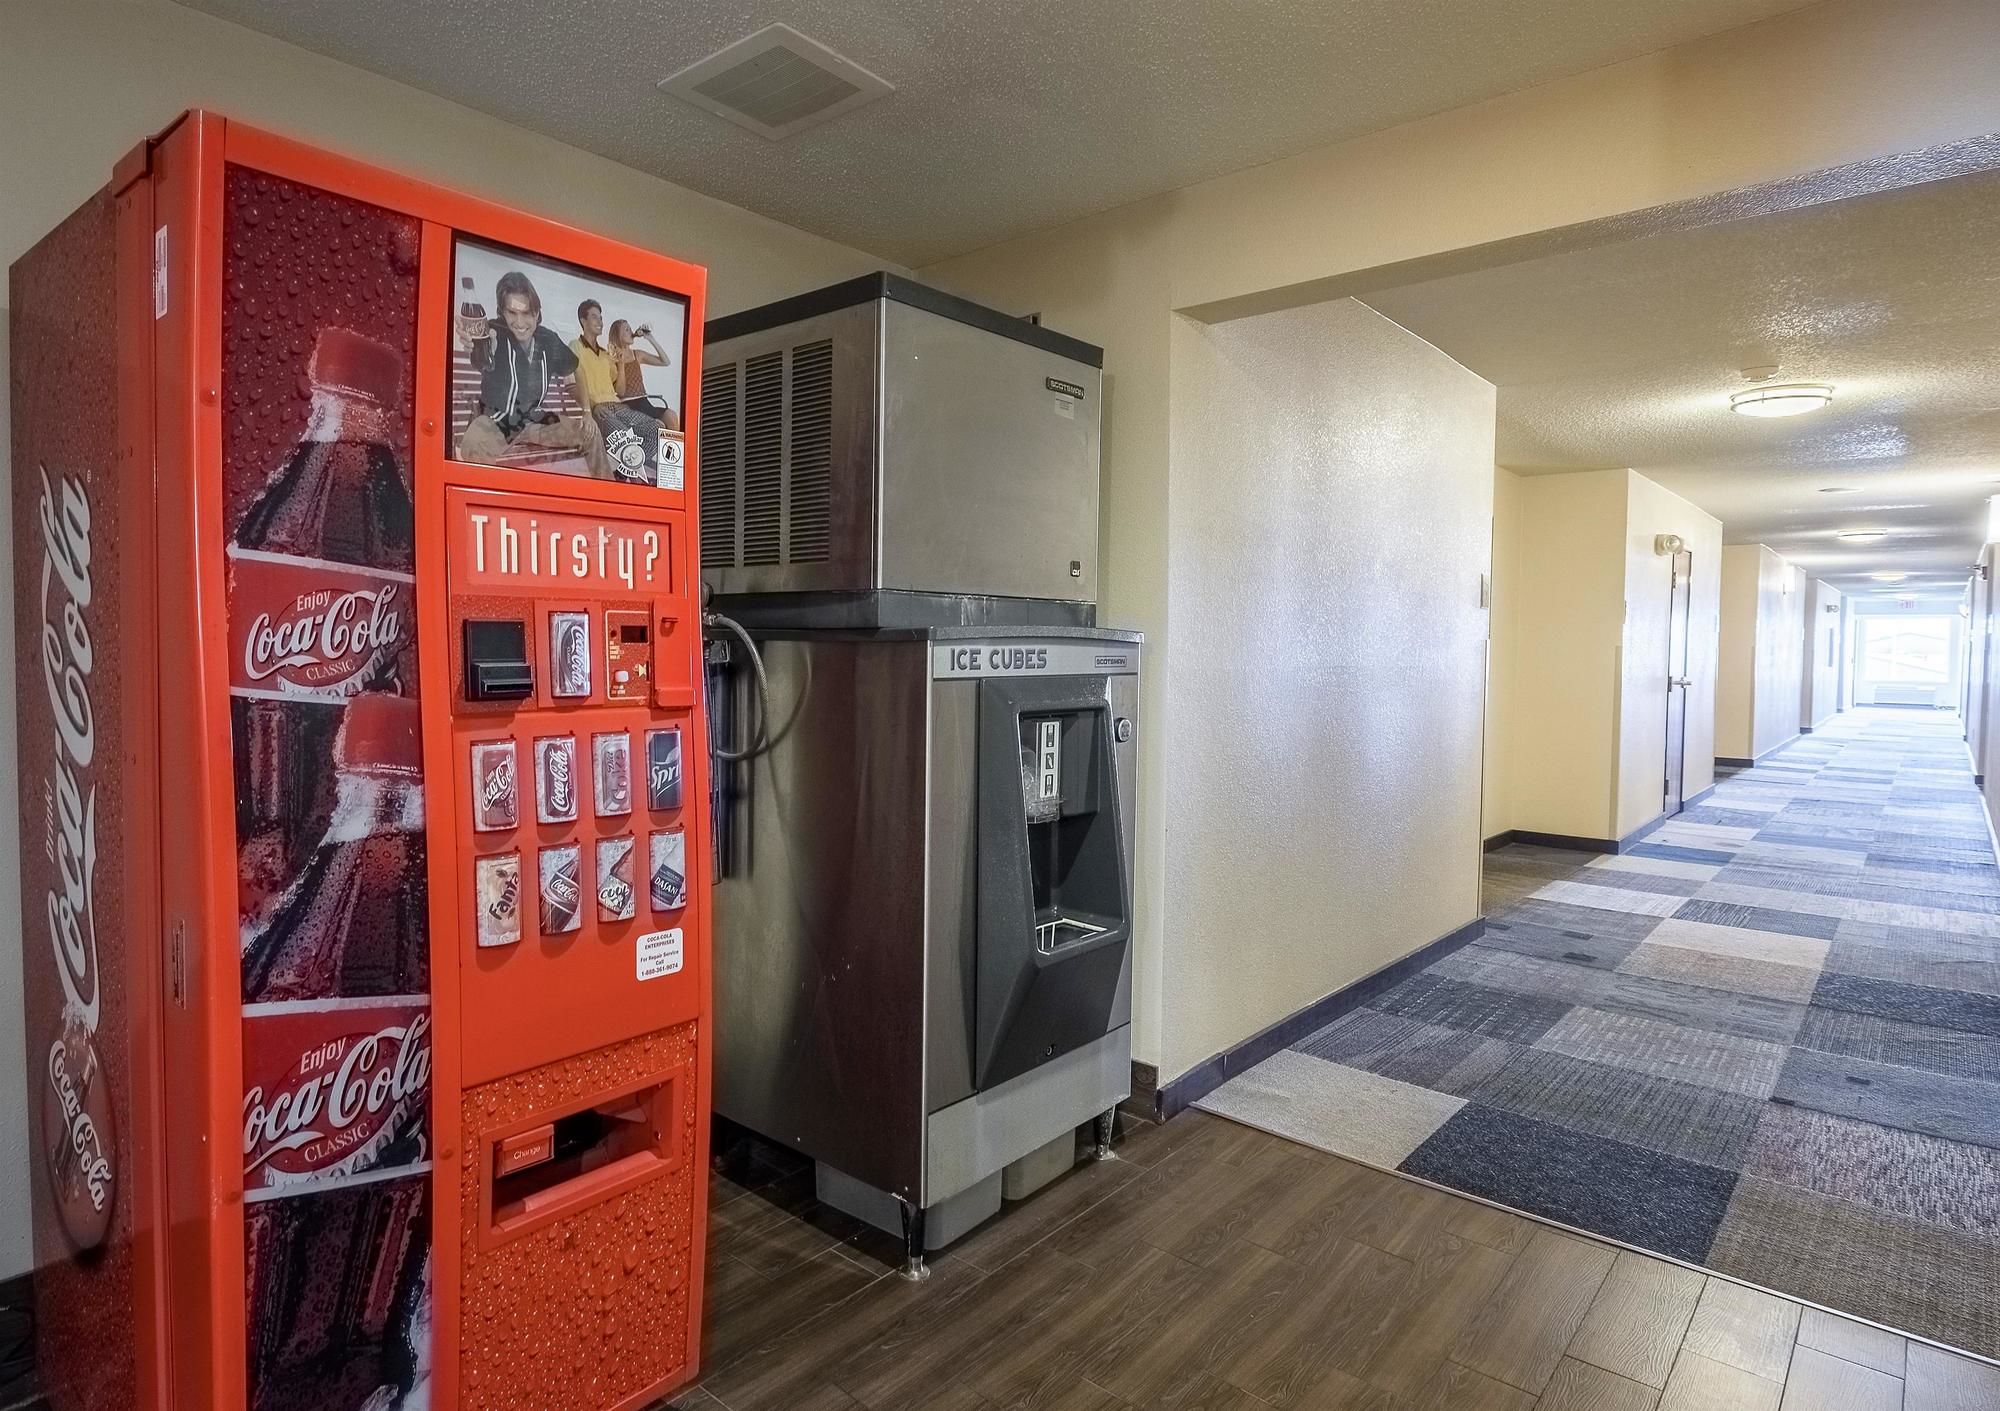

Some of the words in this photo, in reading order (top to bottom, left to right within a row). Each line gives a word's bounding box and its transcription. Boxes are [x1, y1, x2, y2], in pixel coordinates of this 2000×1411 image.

[471, 514, 658, 590] Thirsty?
[296, 590, 331, 611] Enjoy
[245, 583, 400, 680] Coca-Cola
[306, 659, 356, 681] CLASSIC
[950, 648, 982, 671] ICE
[989, 648, 1048, 670] CUBES
[40, 463, 100, 1033] Coca-Cola
[550, 748, 570, 812] Coca-Cola
[654, 876, 679, 896] DASANI
[647, 933, 673, 943] COCA-COLA
[300, 1037, 347, 1075] Enjoy
[50, 1039, 112, 1212] Coca-Cola
[304, 1121, 371, 1163] CLASSIC
